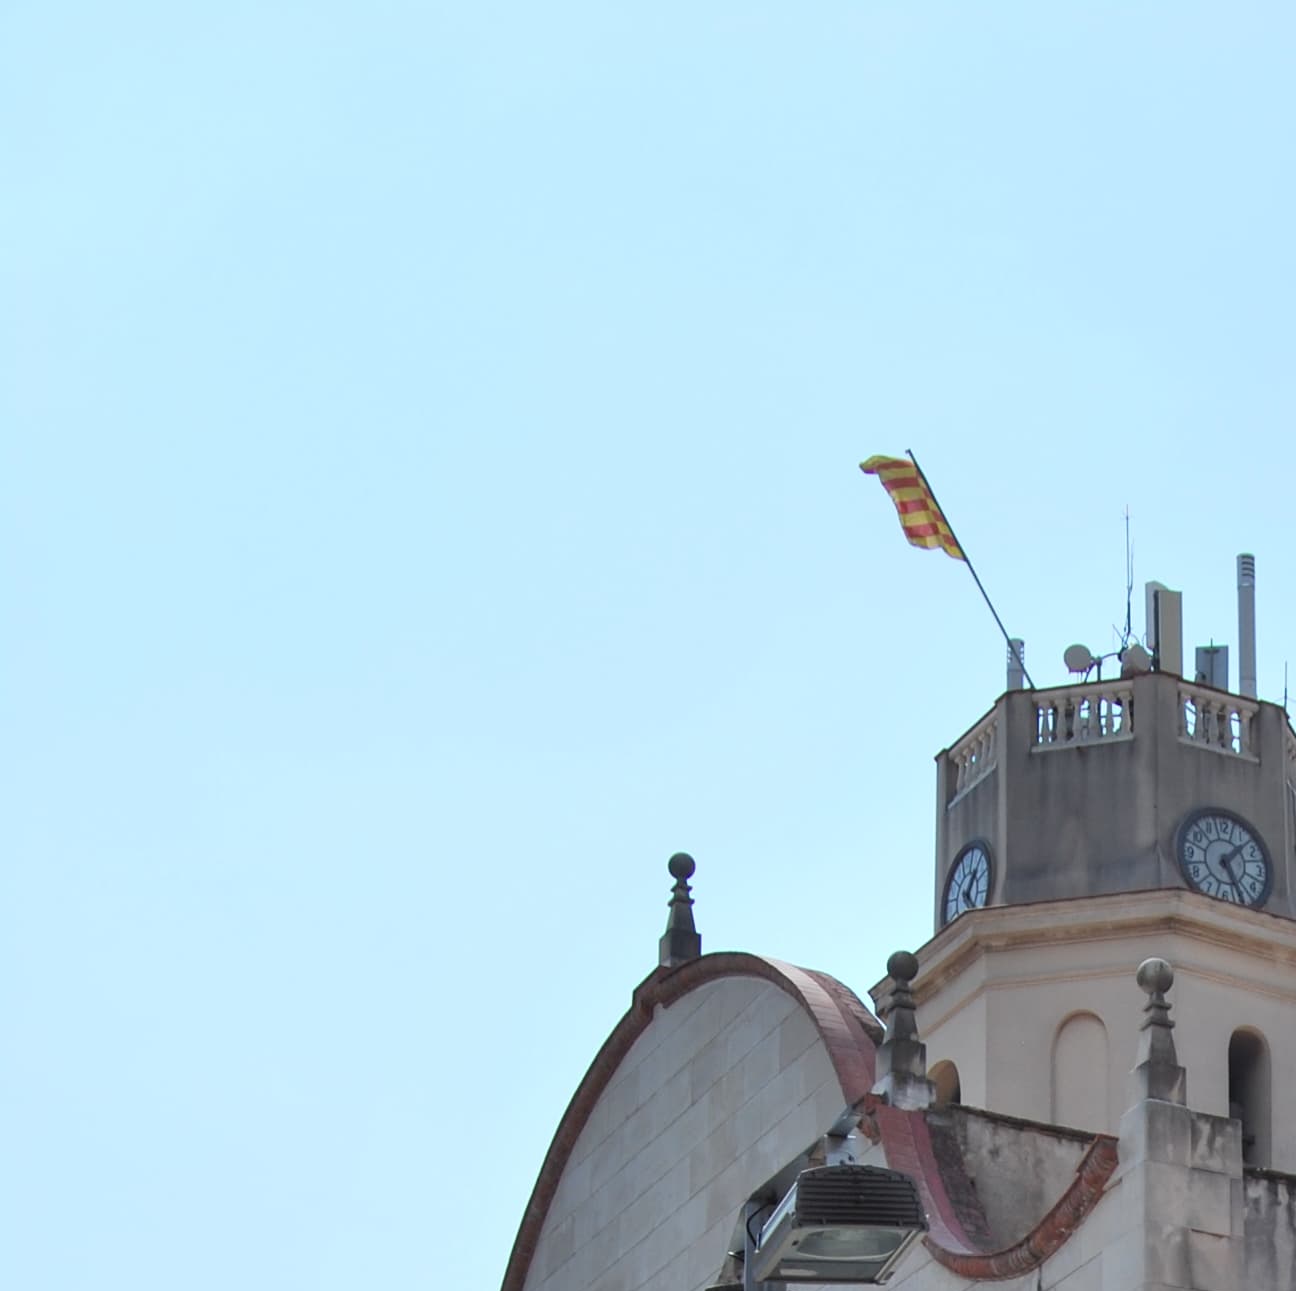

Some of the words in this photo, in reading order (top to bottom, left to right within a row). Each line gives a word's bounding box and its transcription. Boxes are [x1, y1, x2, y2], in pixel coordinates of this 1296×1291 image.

[1220, 822, 1230, 834] 12
[1187, 846, 1195, 858] 9
[1250, 845, 1257, 858] 2
[1192, 865, 1200, 878] 8
[1255, 865, 1263, 877] 3
[1204, 881, 1212, 892] 7
